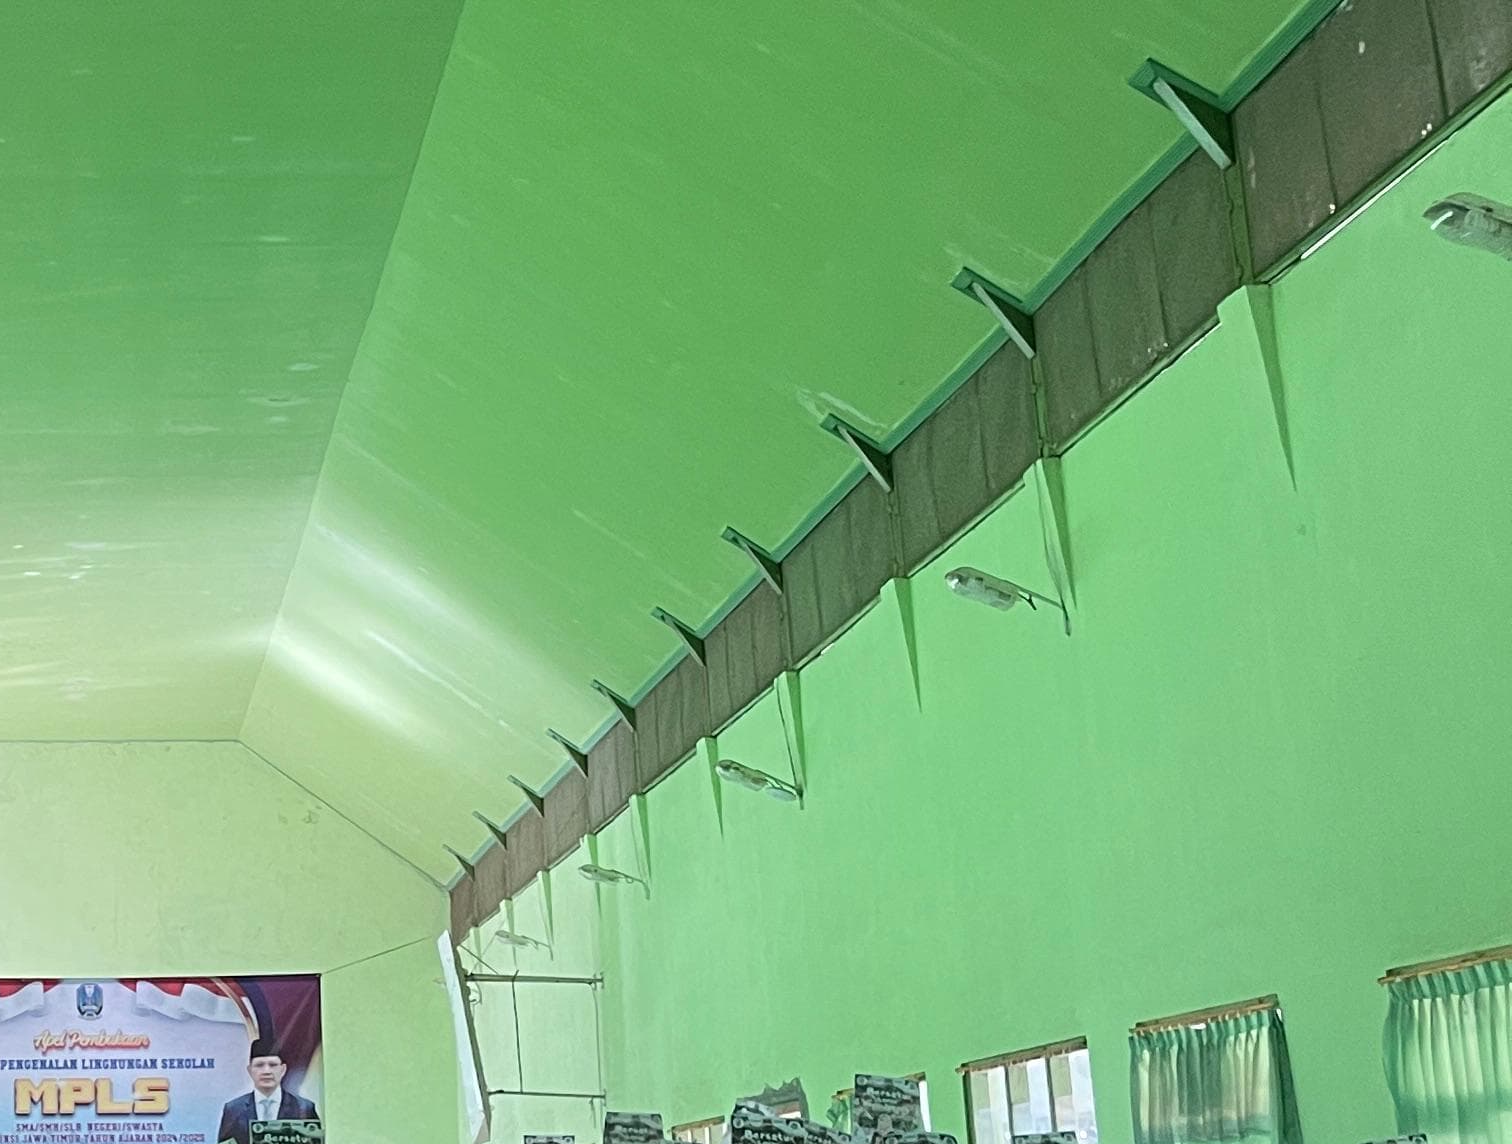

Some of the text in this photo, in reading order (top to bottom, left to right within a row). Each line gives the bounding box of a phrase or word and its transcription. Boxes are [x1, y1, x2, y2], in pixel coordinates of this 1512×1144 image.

[68, 1029, 150, 1050] Pembukaan
[0, 1058, 77, 1070] PENGENALAN
[81, 1058, 157, 1070] LINGKUNGAN
[161, 1058, 215, 1069] SEKOLAH
[14, 1077, 170, 1115] MPLS
[23, 1134, 47, 1143] JAWA
[51, 1134, 81, 1143] TIMUR
[84, 1133, 115, 1142] TAHUN
[118, 1133, 153, 1142] AJARAN
